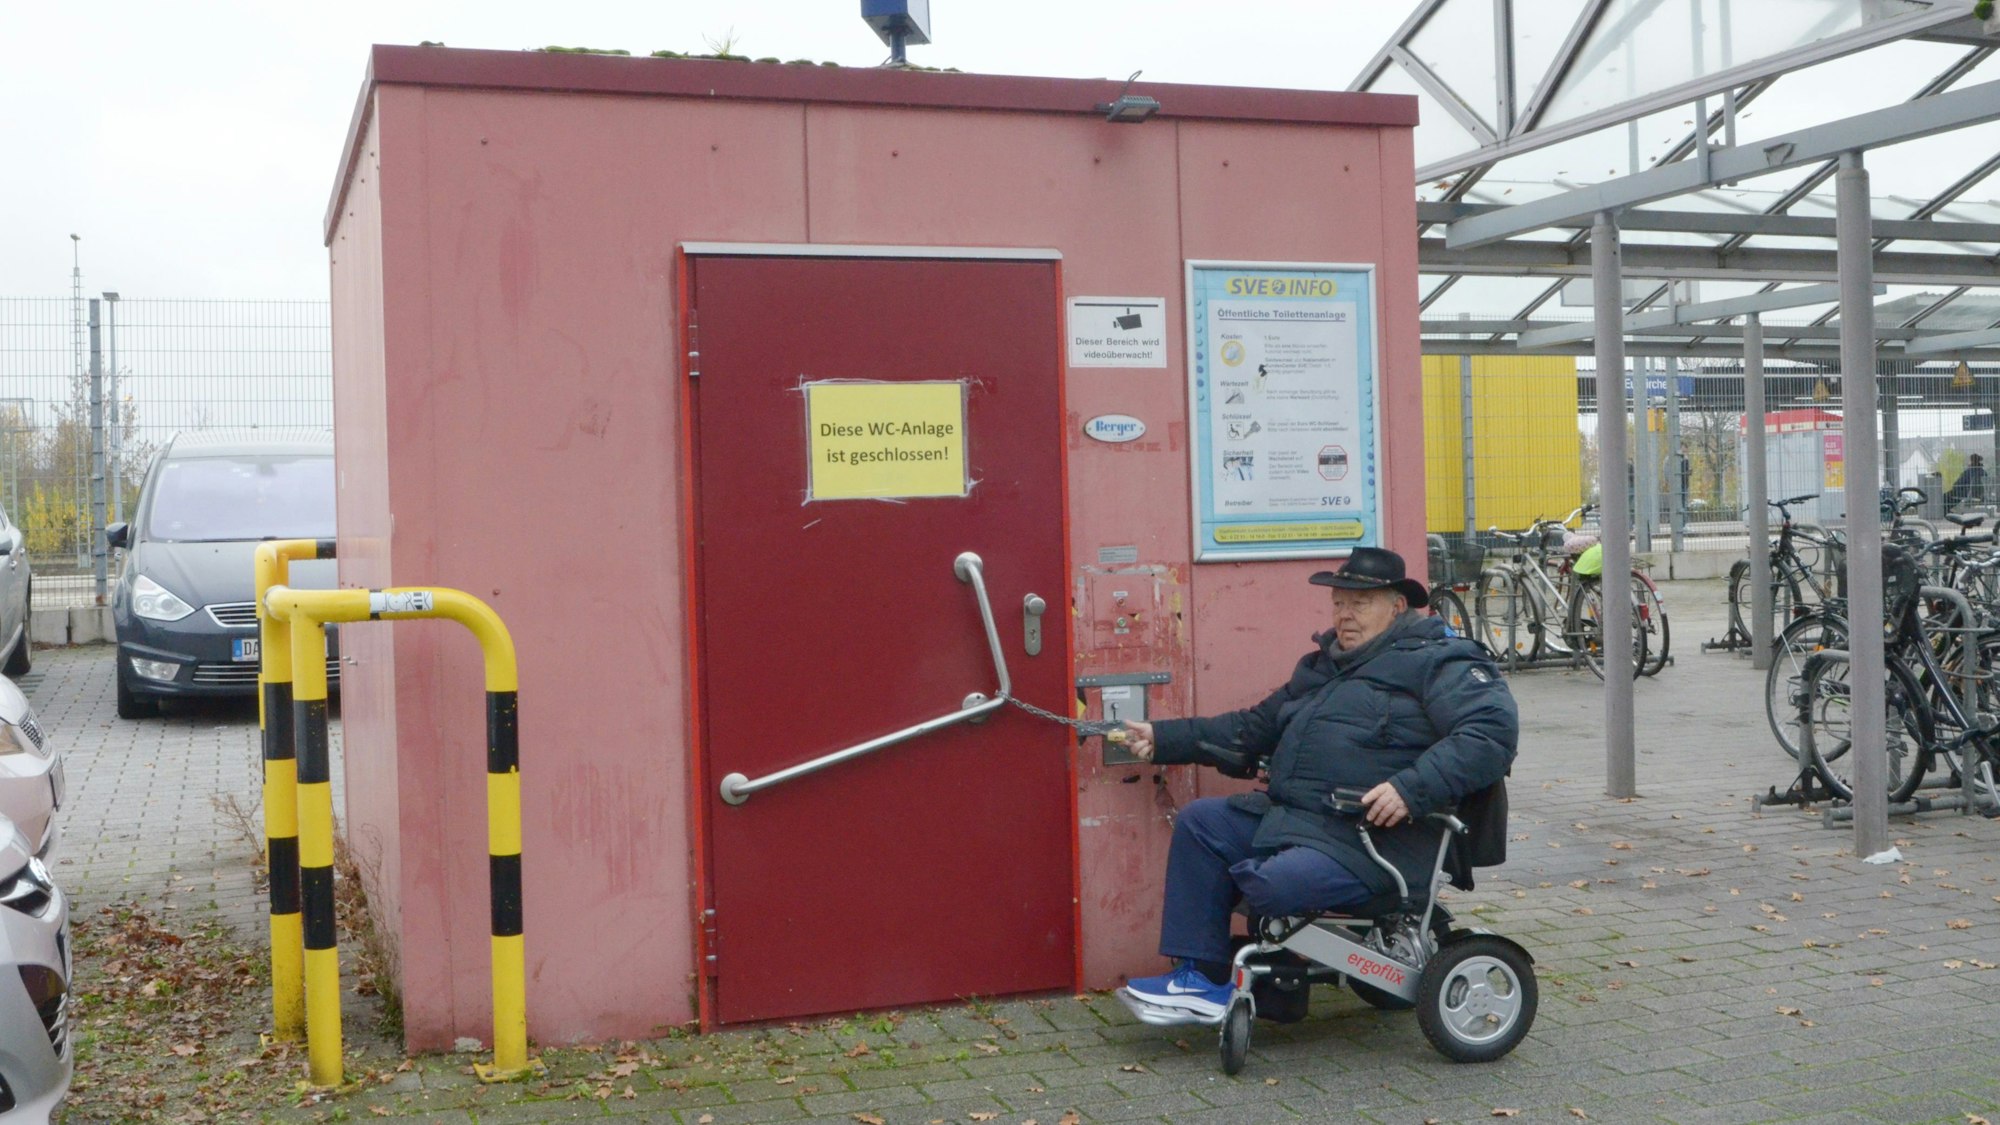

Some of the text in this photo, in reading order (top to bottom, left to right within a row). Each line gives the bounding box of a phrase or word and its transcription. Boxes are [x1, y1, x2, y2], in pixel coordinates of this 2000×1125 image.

[1230, 278, 1333, 296] SVE INFO
[1217, 308, 1346, 321] Öffentliche Toilettenanlage
[1075, 337, 1160, 347] Dieser Bereich wird
[1083, 350, 1153, 360] videoüberwacht!
[820, 421, 954, 438] Diese WC-Anlage
[1095, 420, 1137, 436] Berger
[827, 446, 949, 465] ist geschlossen!
[1321, 496, 1342, 506] SVE
[1347, 953, 1406, 985] ergoflix
